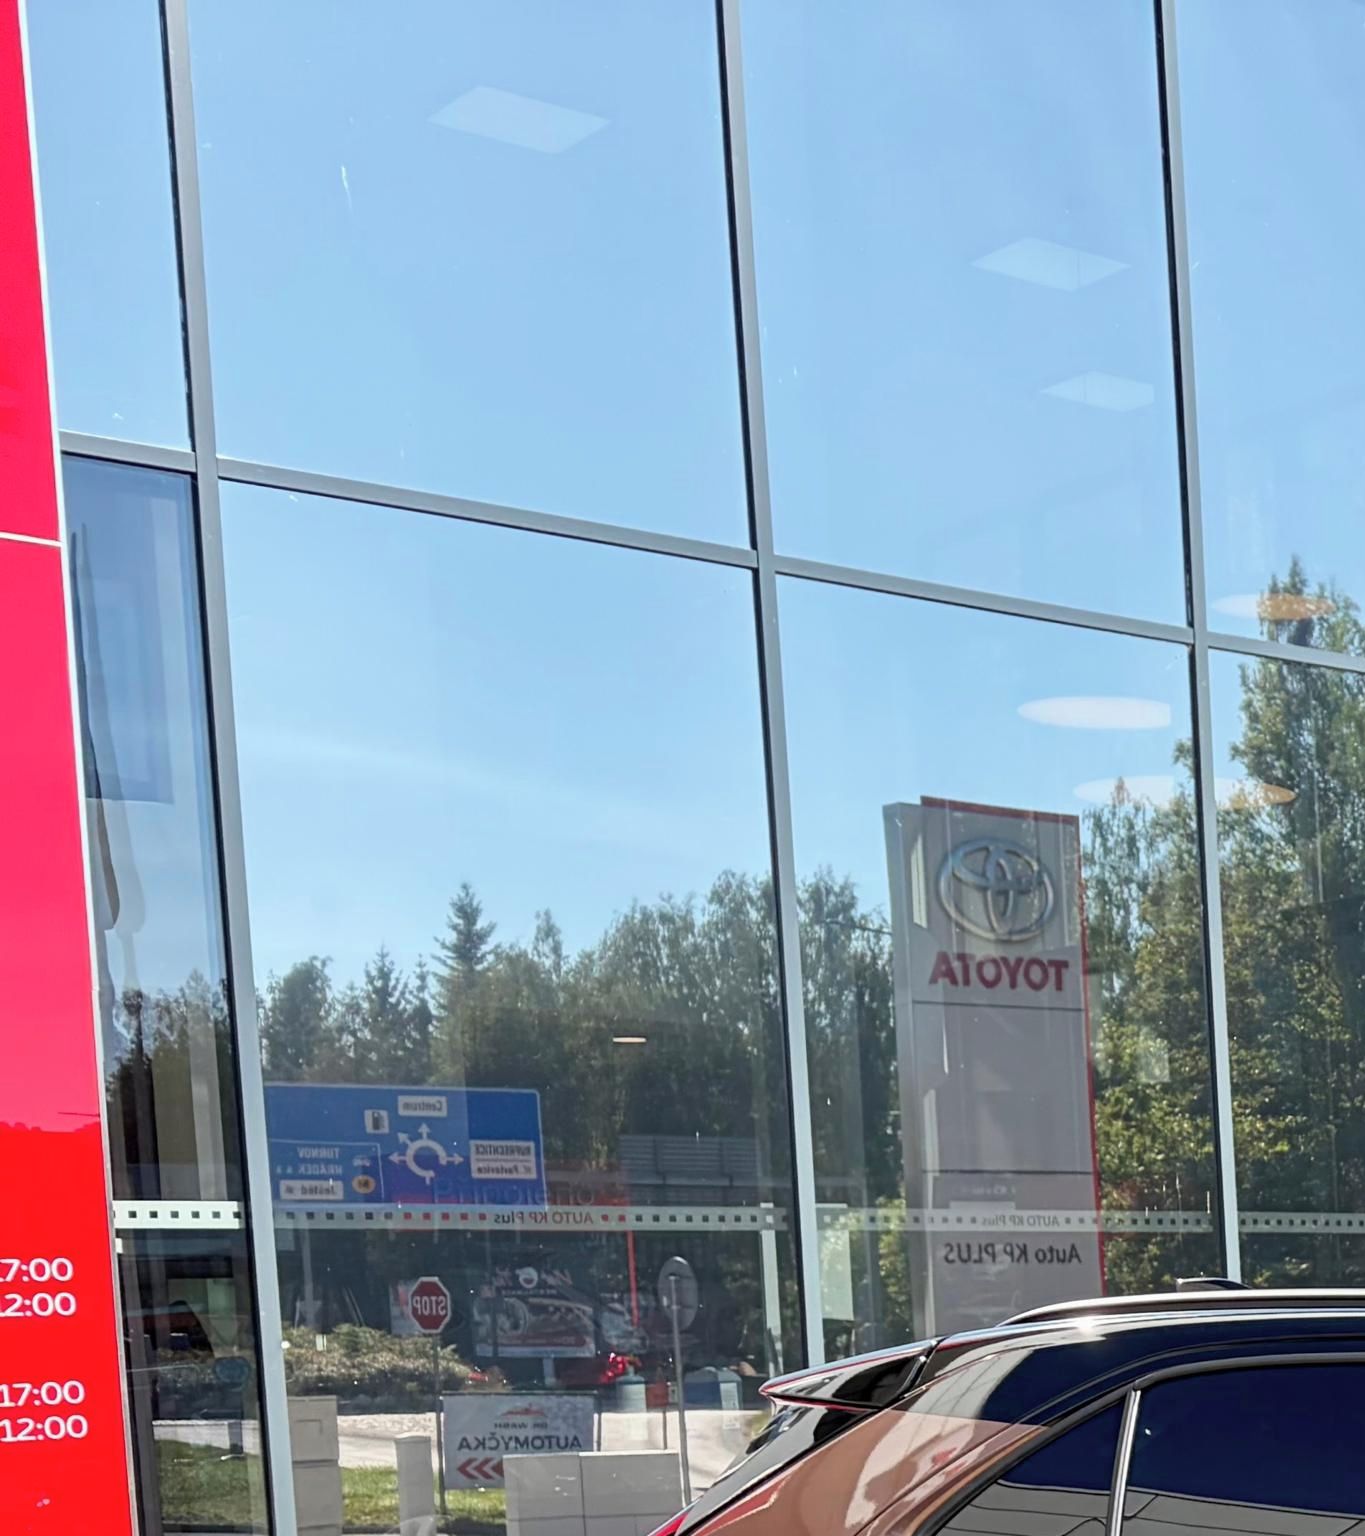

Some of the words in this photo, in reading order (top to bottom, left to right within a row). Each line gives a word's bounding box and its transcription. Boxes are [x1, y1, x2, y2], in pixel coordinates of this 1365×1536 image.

[0, 1258, 74, 1282] 7:00
[0, 1292, 77, 1317] 2:00
[0, 1380, 85, 1407] 17:00
[0, 1415, 88, 1442] 12:00
